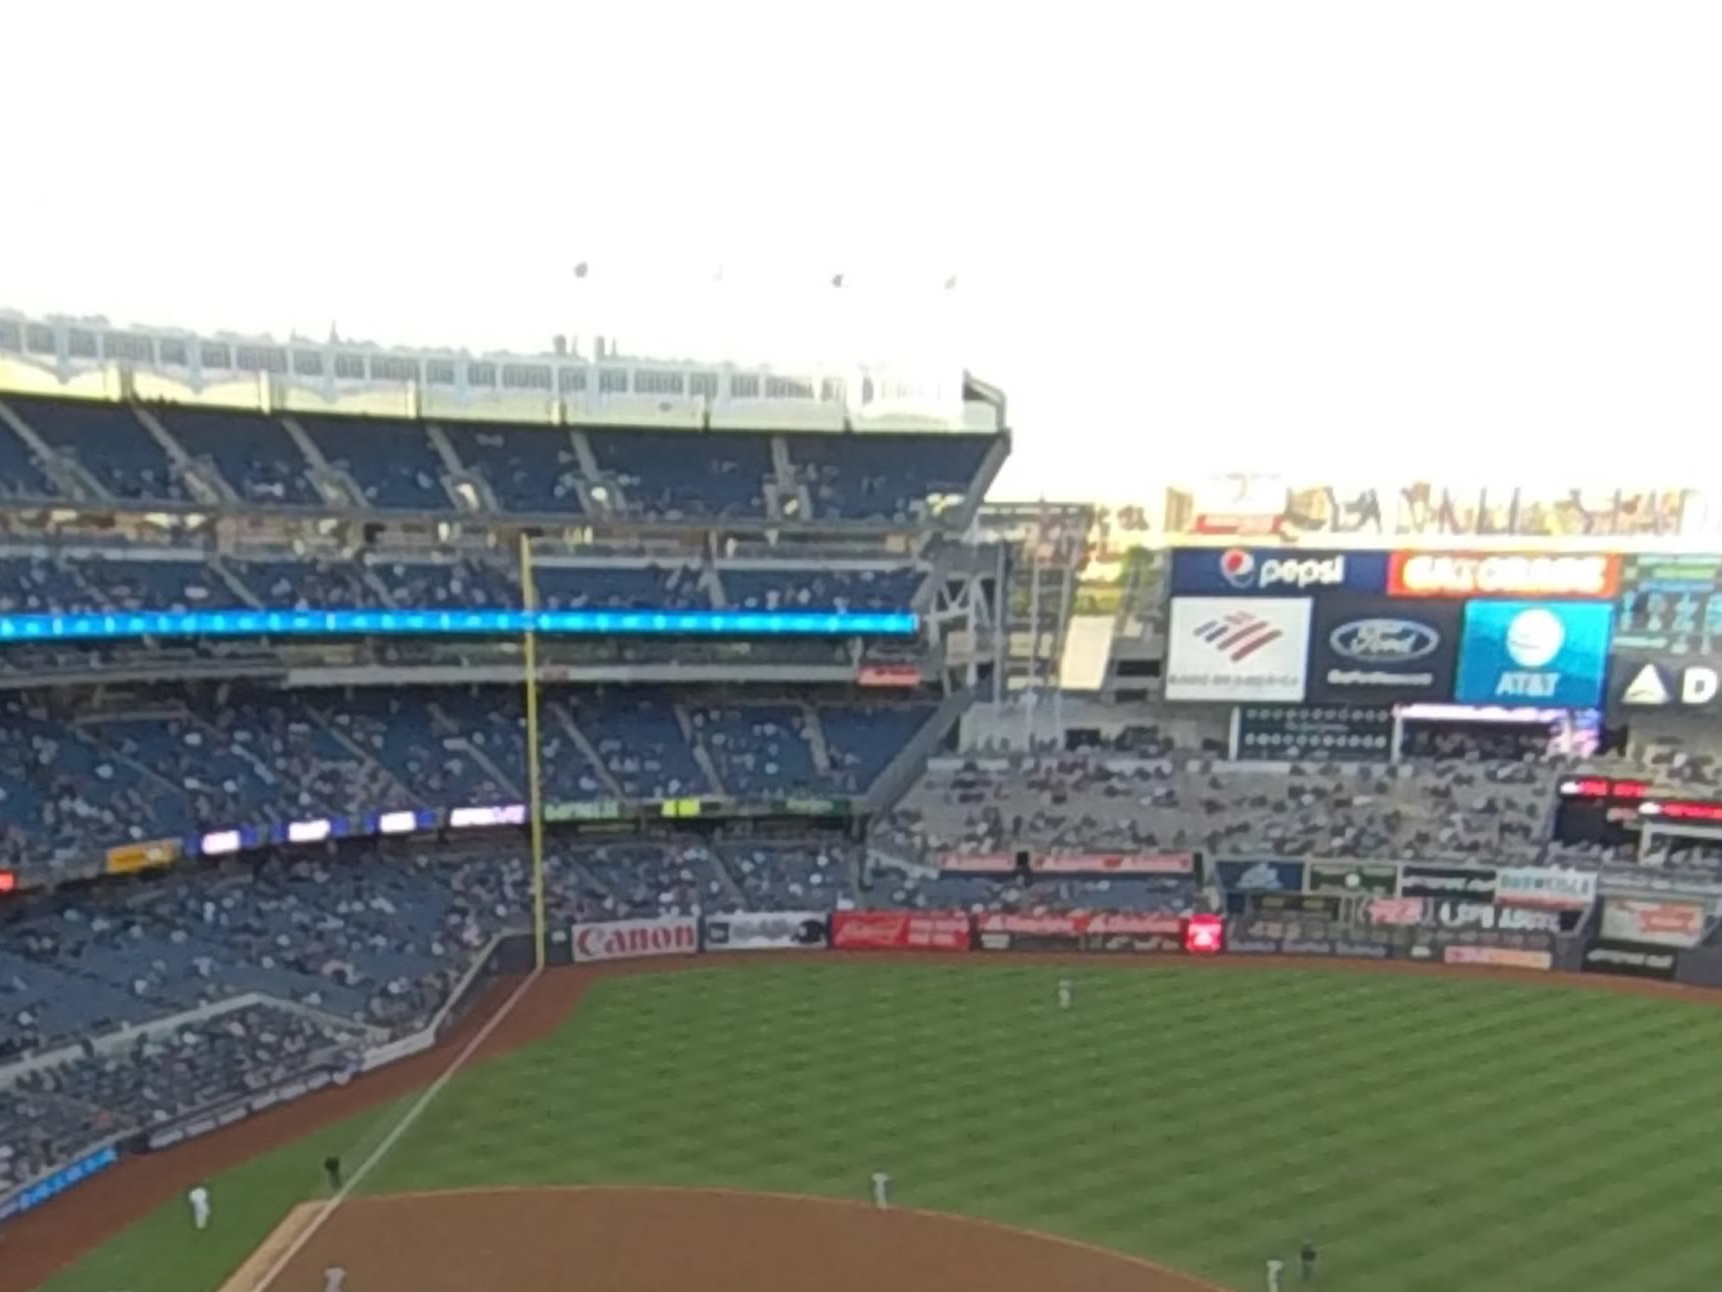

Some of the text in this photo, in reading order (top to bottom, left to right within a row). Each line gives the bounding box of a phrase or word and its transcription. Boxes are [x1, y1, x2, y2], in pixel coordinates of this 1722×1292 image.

[1258, 554, 1344, 589] pepsi
[1348, 623, 1418, 656] Ford
[1495, 671, 1561, 697] AT&T
[578, 924, 695, 957] Canon
